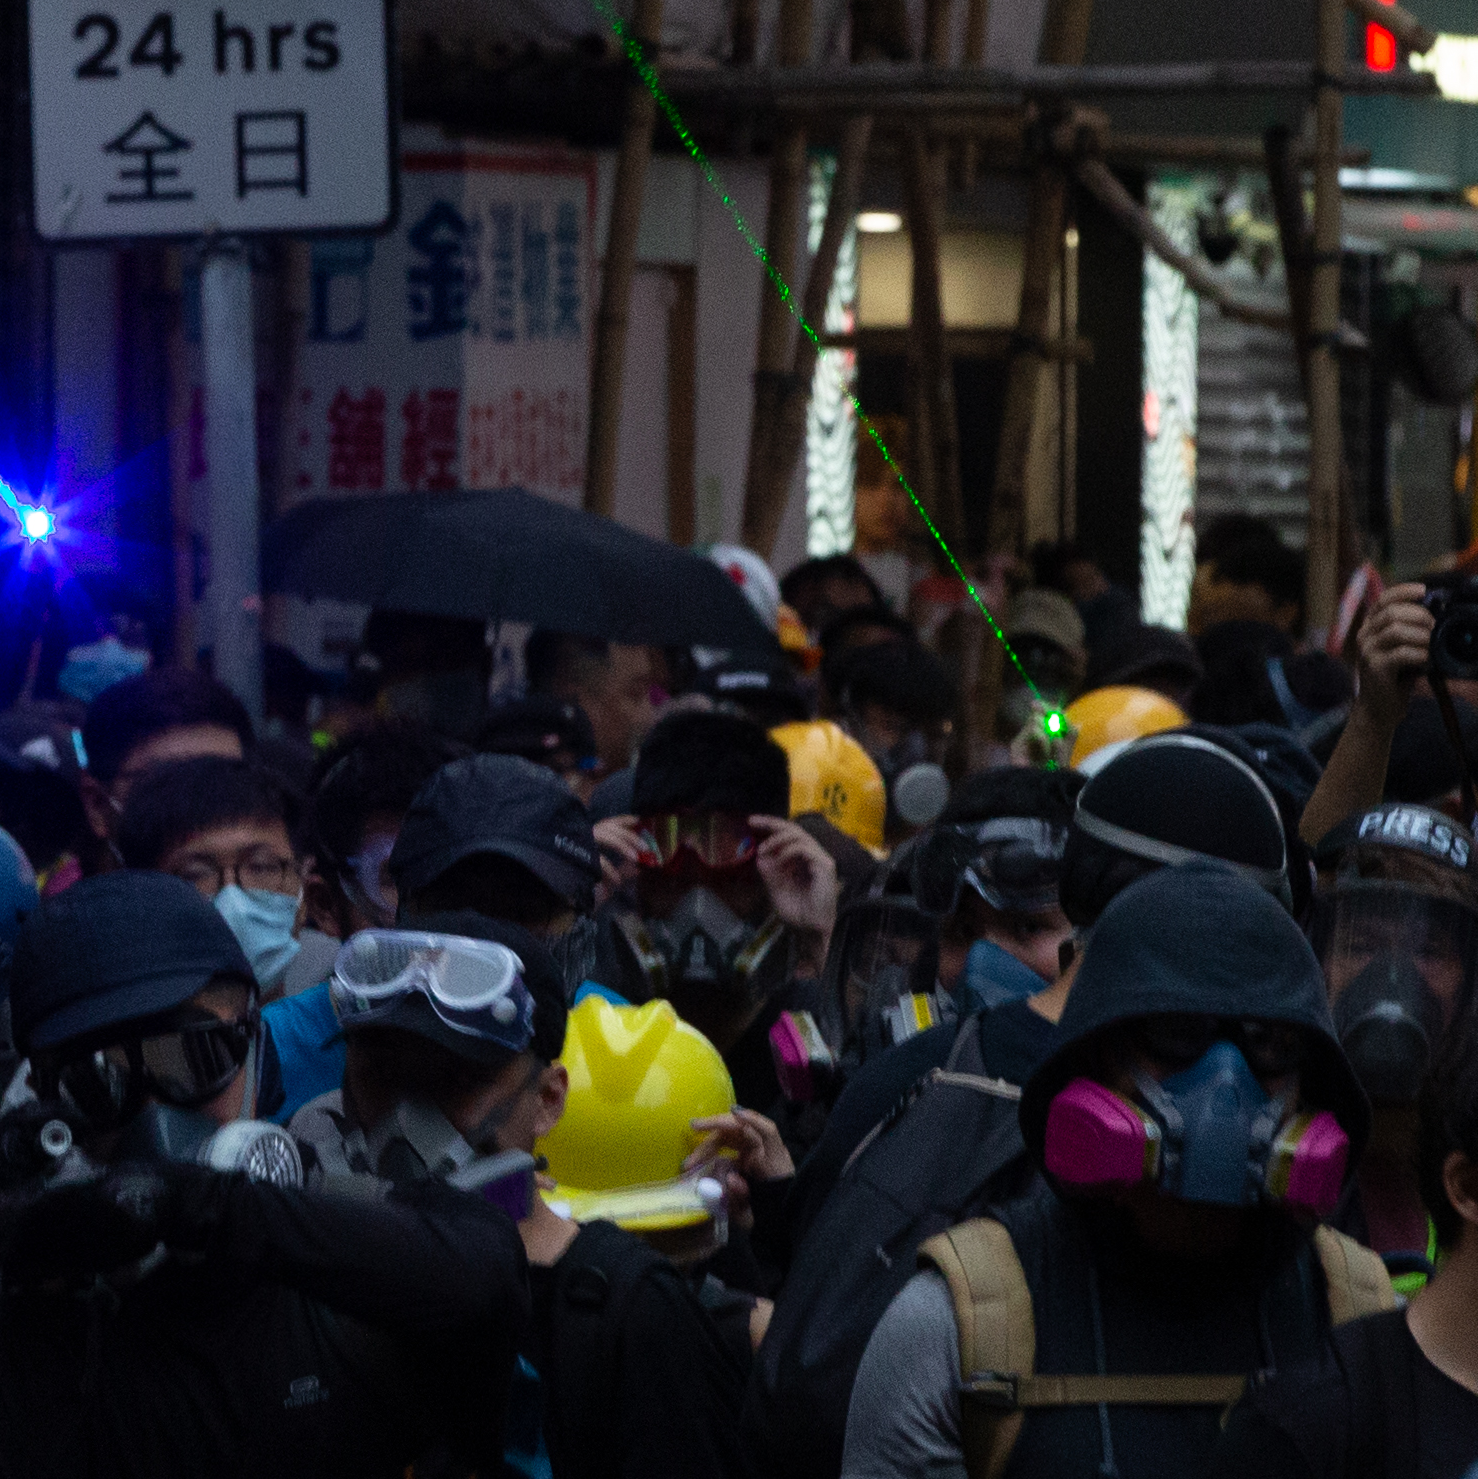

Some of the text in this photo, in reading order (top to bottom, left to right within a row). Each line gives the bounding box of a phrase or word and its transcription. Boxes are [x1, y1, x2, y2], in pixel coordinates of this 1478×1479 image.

[73, 10, 342, 78] 24 hrs
[103, 110, 310, 203] 全日
[1357, 806, 1472, 869] PRESS
